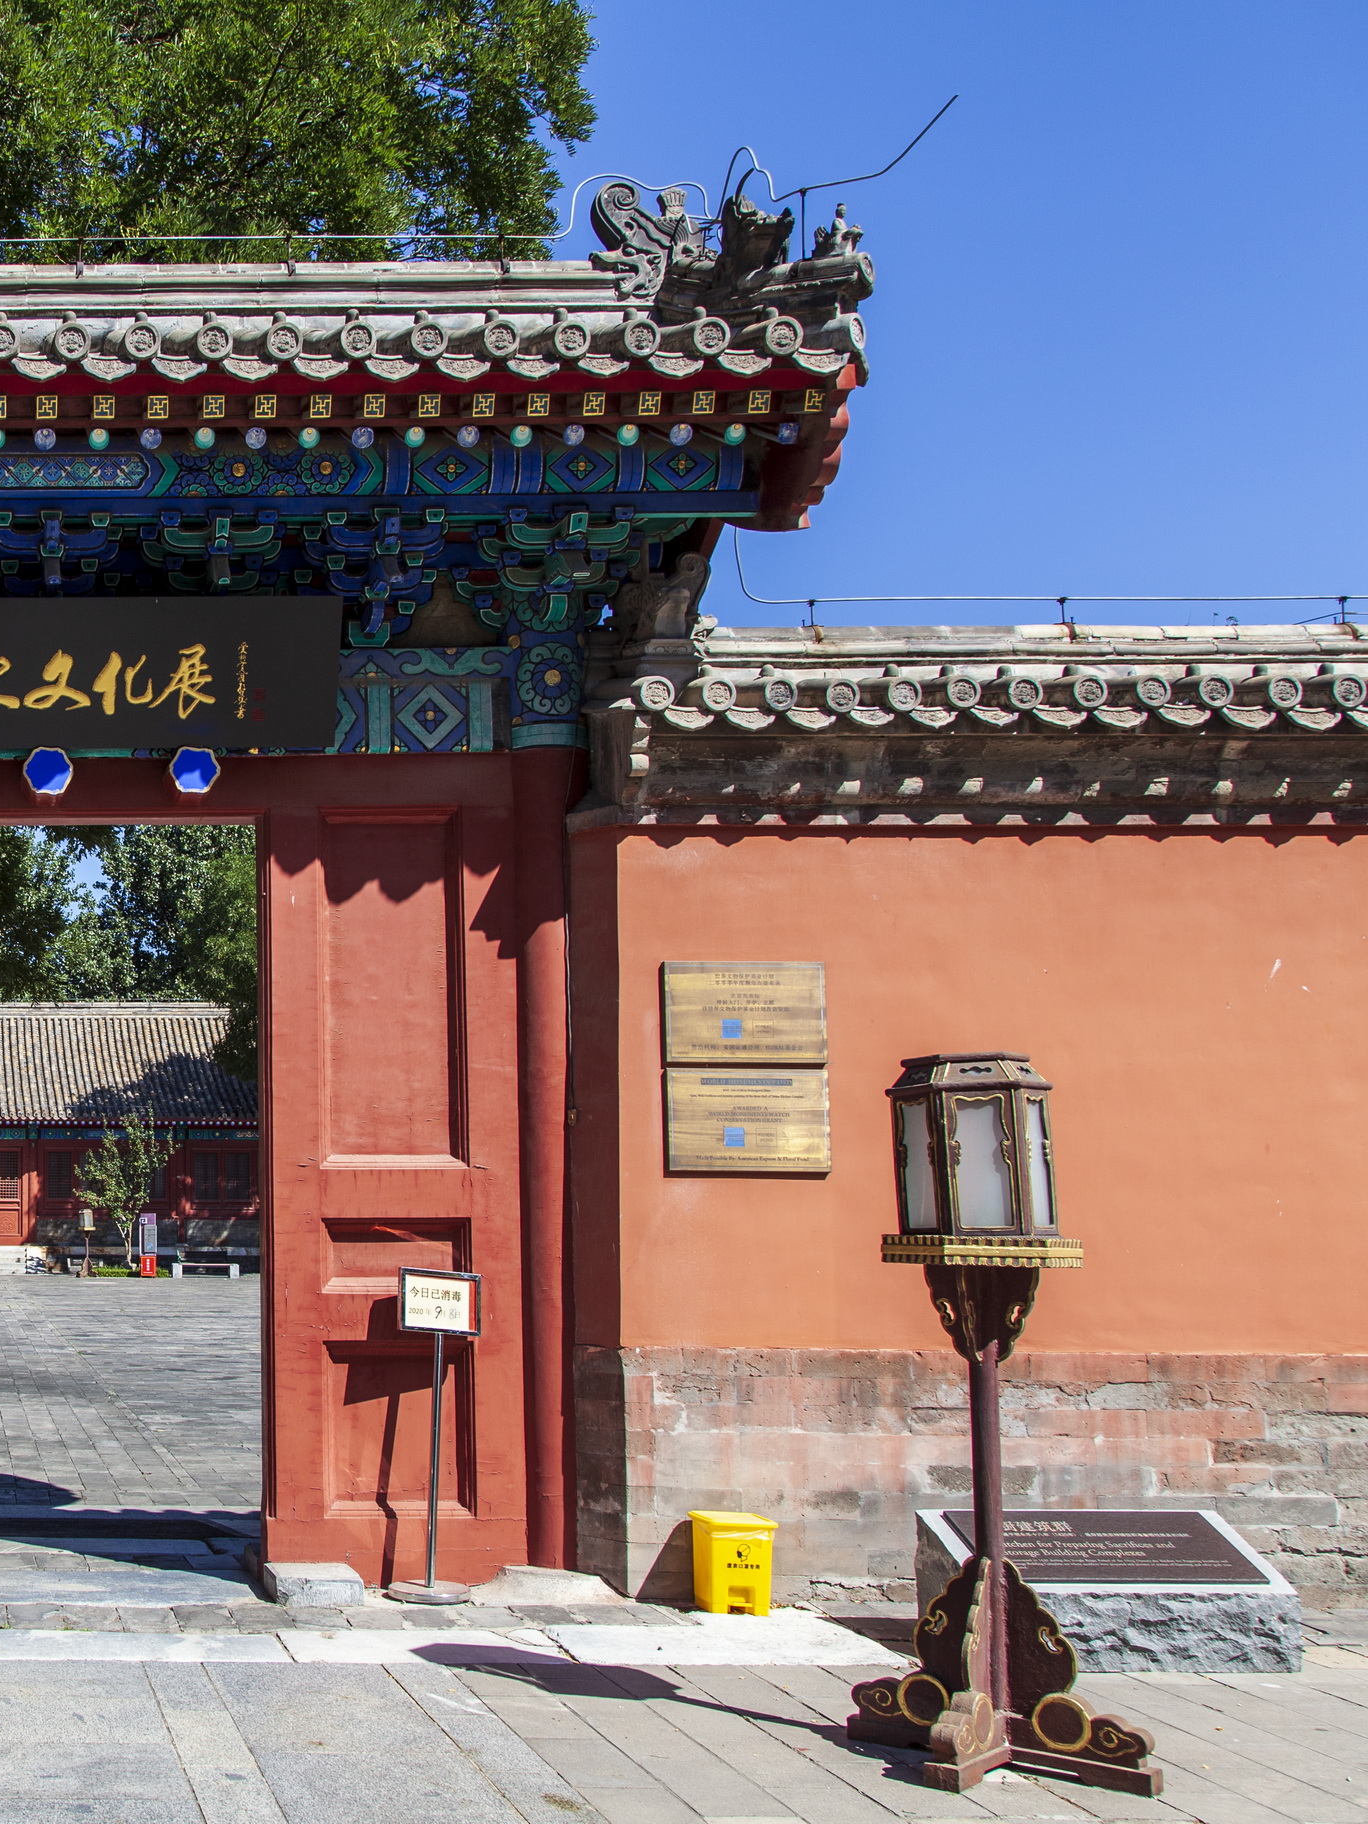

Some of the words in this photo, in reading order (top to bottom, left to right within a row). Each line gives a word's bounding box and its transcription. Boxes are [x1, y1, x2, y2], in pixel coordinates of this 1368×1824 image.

[409, 1286, 461, 1302] 今日已消毒
[1003, 1540, 1036, 1548] itchen
[1037, 1540, 1054, 1548] for
[1053, 1540, 1107, 1550] Preparing
[1105, 1540, 1155, 1549] Sacrifices
[1155, 1541, 1177, 1549] and
[1040, 1549, 1089, 1558] Building
[1088, 1548, 1147, 1558] Complexes
